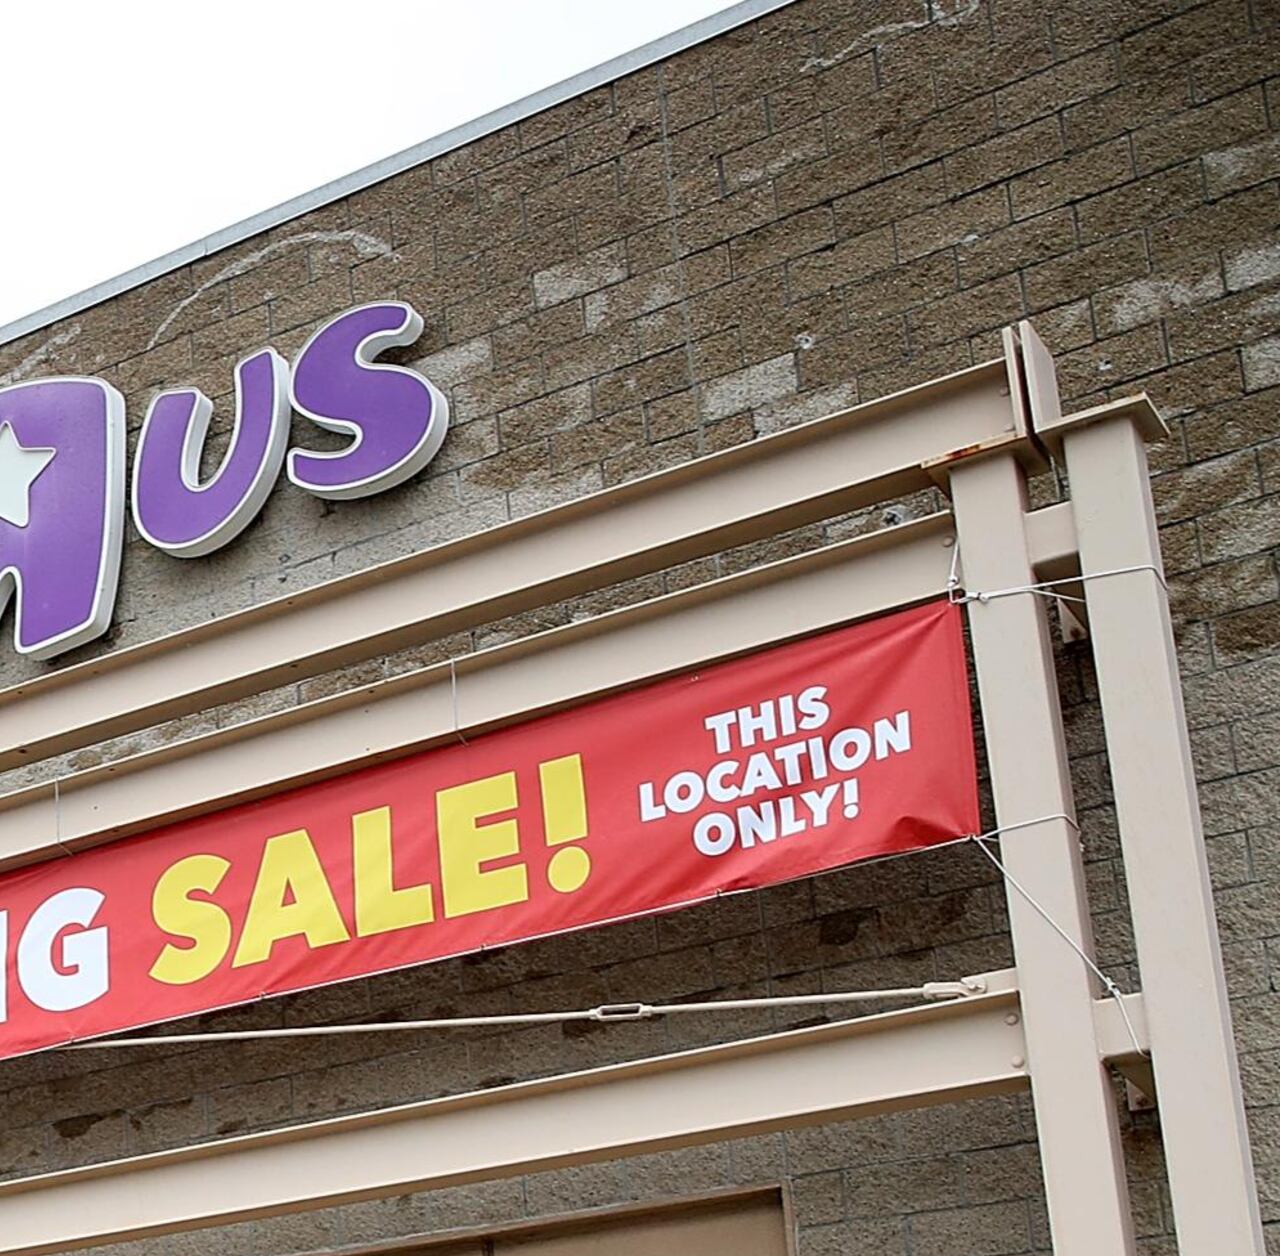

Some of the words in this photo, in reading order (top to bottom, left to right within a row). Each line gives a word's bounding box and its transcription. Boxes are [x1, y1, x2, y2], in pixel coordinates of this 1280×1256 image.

[132, 302, 449, 558] US
[639, 711, 911, 822] LOCATION
[703, 685, 830, 753] THIS
[148, 753, 590, 985] SALE!
[692, 783, 859, 857] ONLY!
